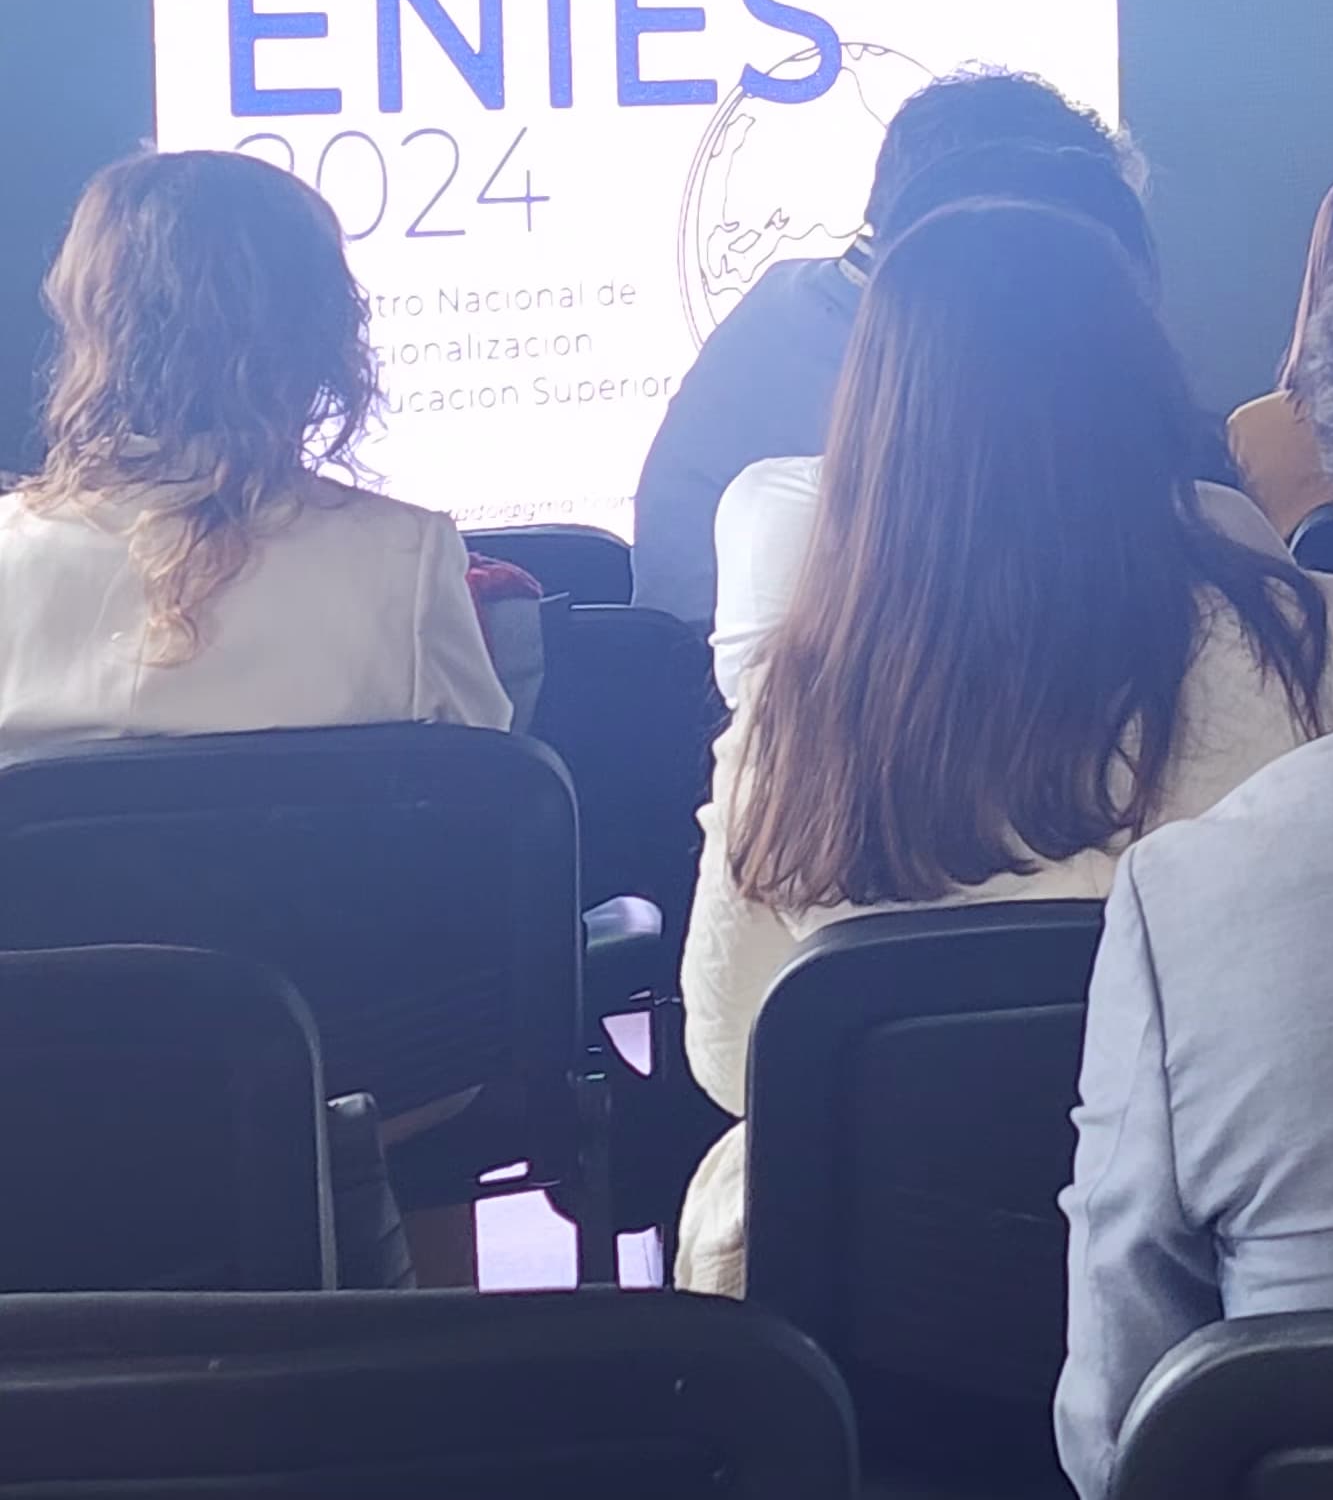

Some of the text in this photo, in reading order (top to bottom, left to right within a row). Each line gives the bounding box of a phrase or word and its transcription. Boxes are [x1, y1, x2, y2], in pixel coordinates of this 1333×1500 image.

[438, 280, 584, 314] Nacional
[597, 278, 637, 306] de
[532, 374, 672, 405] Superior
